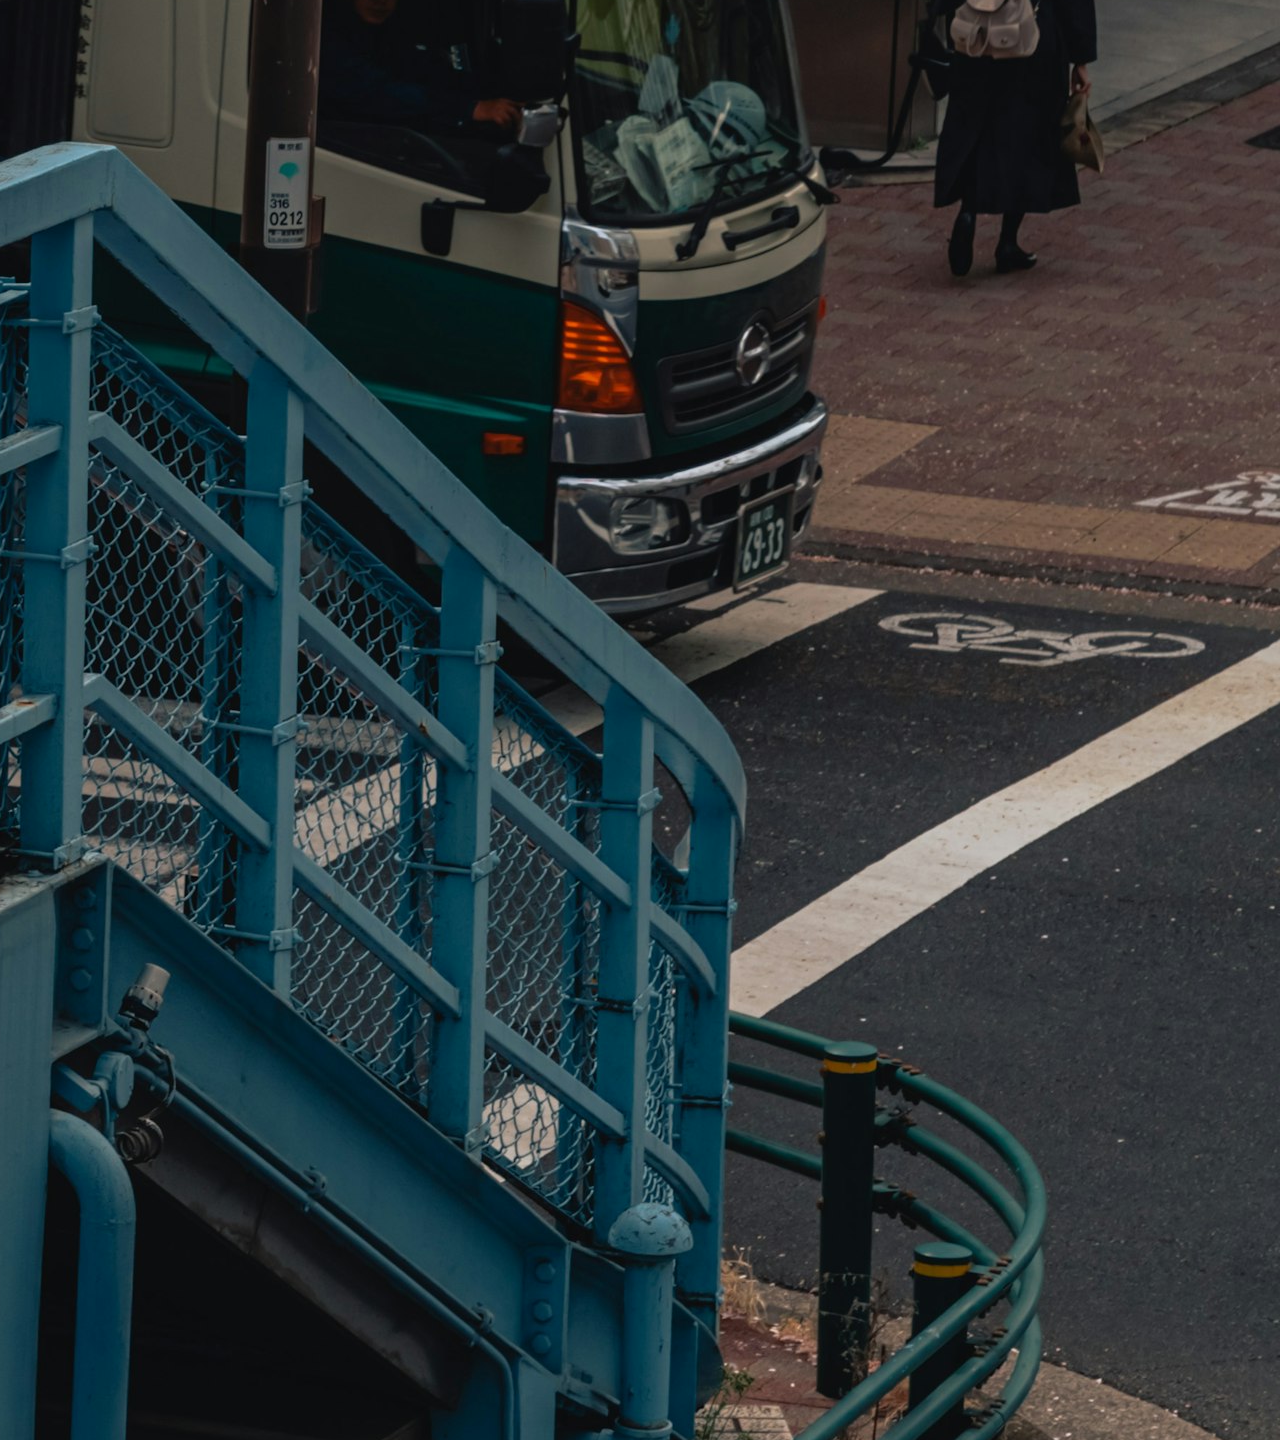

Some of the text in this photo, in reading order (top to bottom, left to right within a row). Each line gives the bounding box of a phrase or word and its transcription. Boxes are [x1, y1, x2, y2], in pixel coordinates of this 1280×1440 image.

[269, 198, 290, 209] 316
[269, 211, 304, 226] 0212
[742, 517, 785, 574] 69-33
